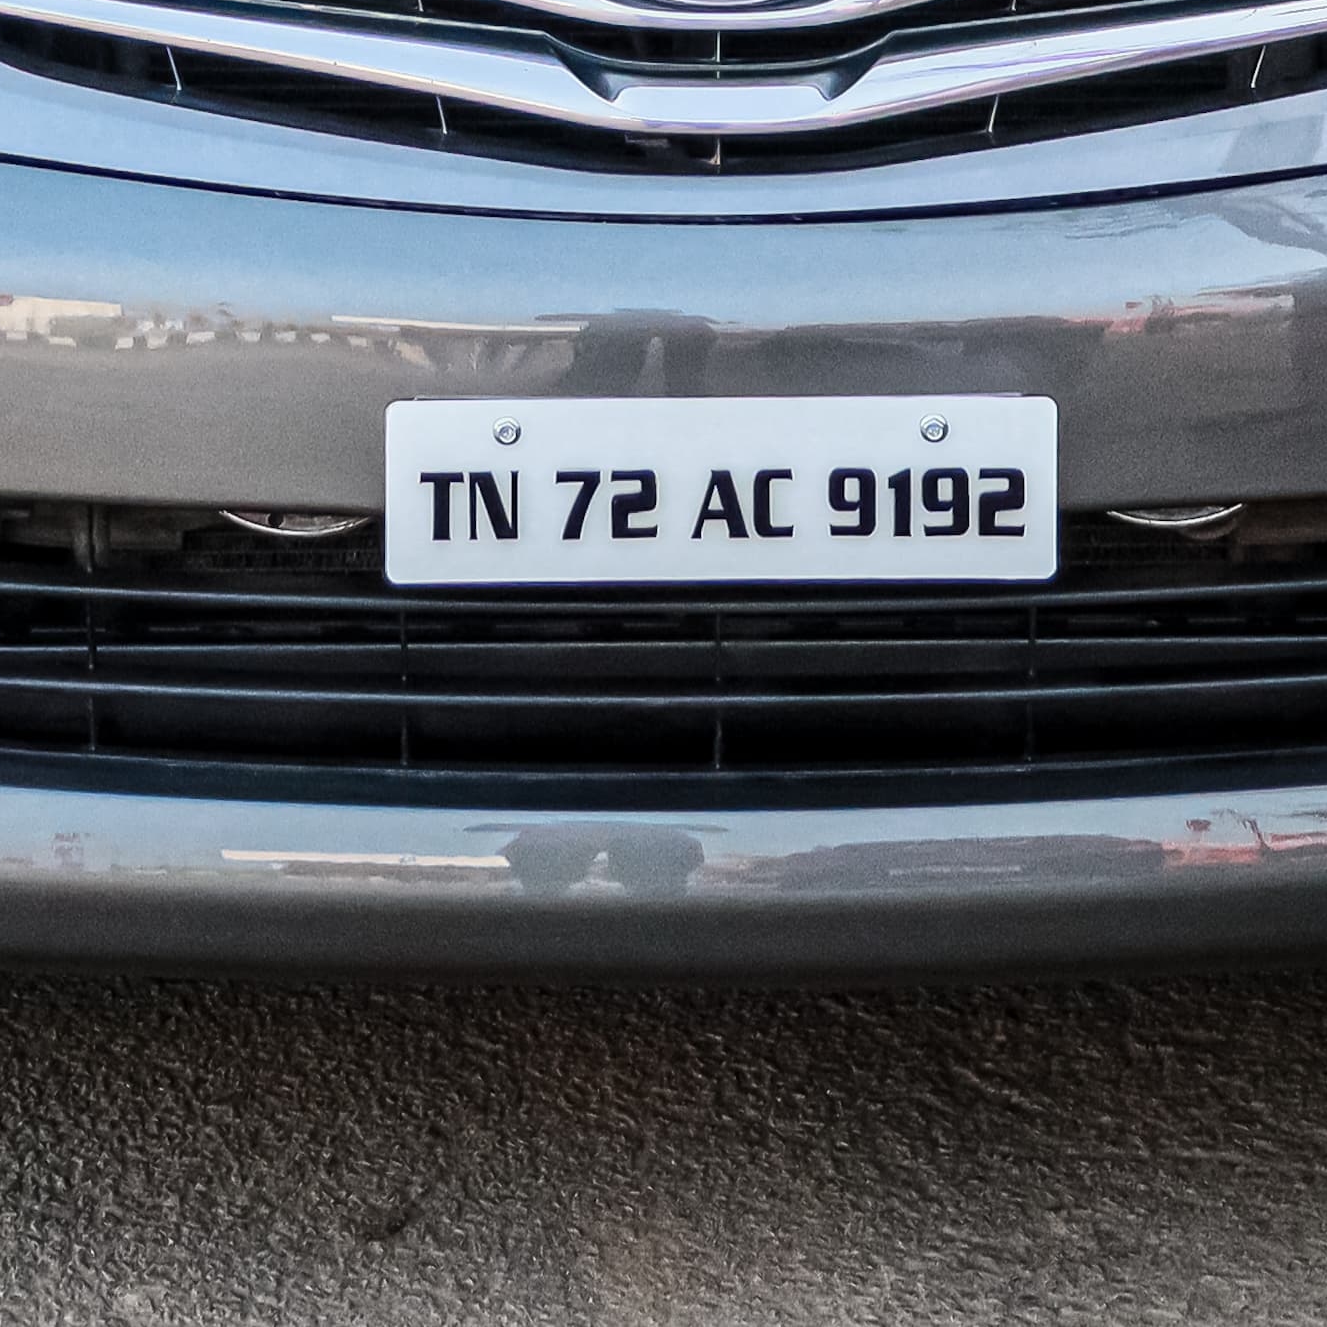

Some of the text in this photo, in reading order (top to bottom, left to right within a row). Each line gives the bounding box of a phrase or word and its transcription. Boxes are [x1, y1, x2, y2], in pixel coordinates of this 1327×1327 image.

[420, 467, 1026, 541] TN 72 AC 9192
